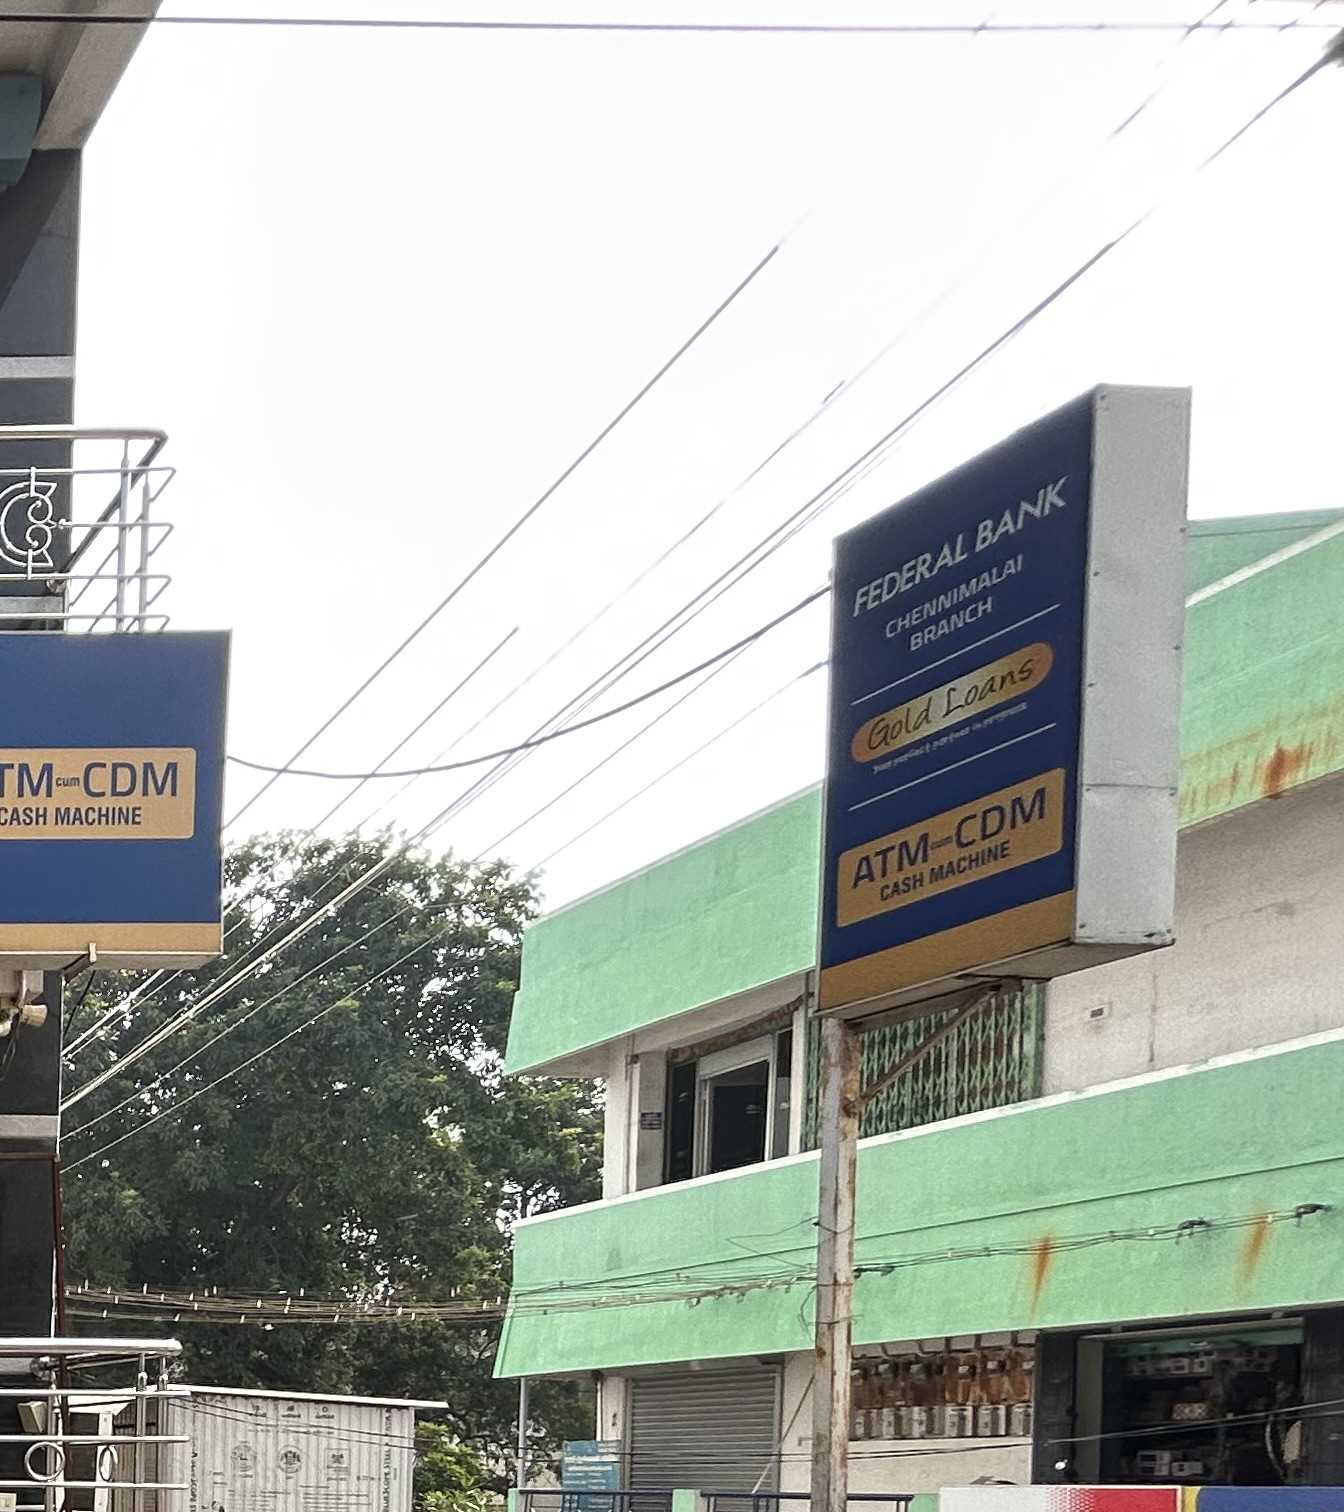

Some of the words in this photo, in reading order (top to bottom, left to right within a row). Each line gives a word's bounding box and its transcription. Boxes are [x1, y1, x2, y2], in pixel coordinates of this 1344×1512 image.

[853, 529, 968, 617] FEDERAL
[976, 476, 1071, 550] BANK
[885, 553, 1024, 639] CHENNIMALAI
[909, 597, 993, 651] BRANCH
[867, 696, 933, 751] Gold
[942, 656, 1034, 718] Loans
[54, 806, 142, 826] MACHINE
[851, 834, 930, 889] ATM
[954, 785, 1048, 851] CDM
[879, 868, 925, 902] CASH
[928, 840, 1011, 891] MACHINE
